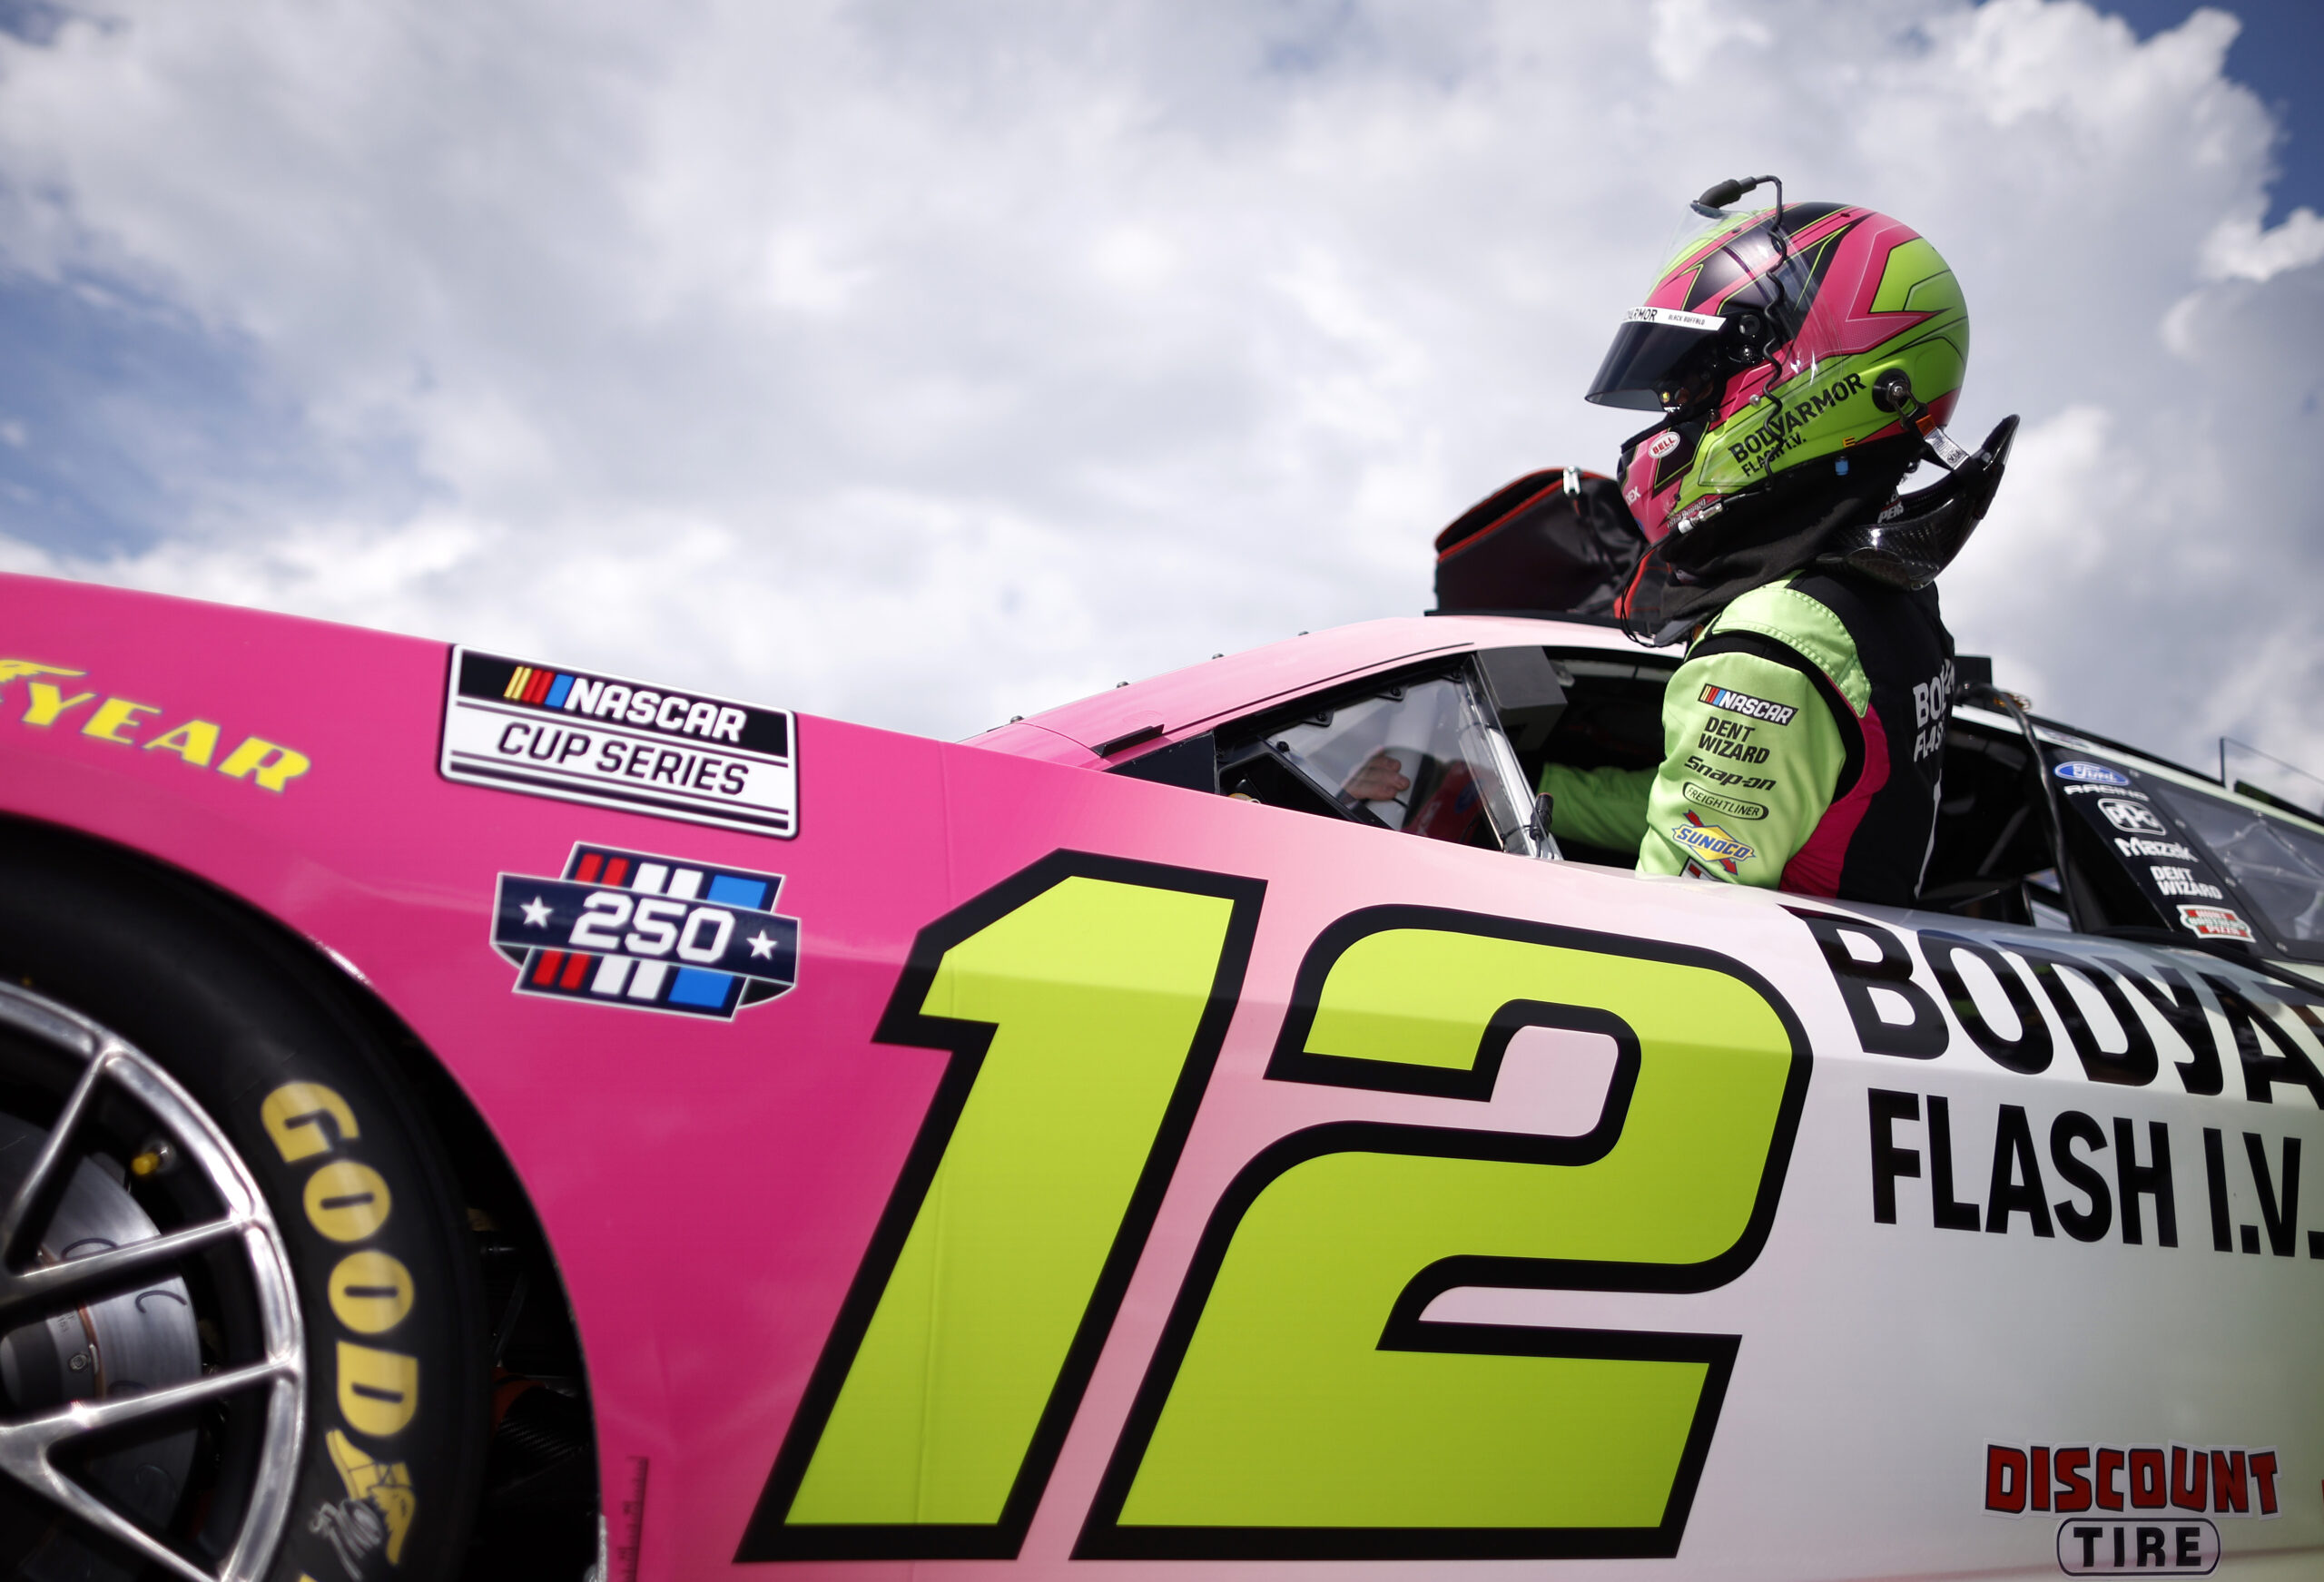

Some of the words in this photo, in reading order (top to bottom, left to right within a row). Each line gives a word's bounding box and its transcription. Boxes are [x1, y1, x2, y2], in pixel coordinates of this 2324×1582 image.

[1652, 436, 1676, 455] BELL
[1728, 372, 1866, 464] BODYARMOR
[21, 681, 311, 792] YEAR
[564, 677, 746, 743] NASCAR
[1704, 716, 1756, 742] DENT
[1718, 690, 1797, 725] NASCAR
[497, 721, 591, 763] CUP
[596, 740, 750, 796] SERIES
[1698, 733, 1770, 764] WIZARD
[1686, 785, 1760, 817] FREIGHTLINER
[1676, 828, 1750, 860] SUNOCO
[2150, 865, 2194, 881] DENT
[2156, 879, 2224, 900] WIZARD
[568, 890, 735, 963] 250
[1777, 904, 2324, 1111] BODYA
[733, 847, 1814, 1561] 12
[1867, 1087, 2179, 1248] FLASH
[2203, 1126, 2324, 1260] I.V.
[261, 1080, 419, 1438] GOOD
[1984, 1444, 2280, 1515] DISCOUNT
[2073, 1527, 2202, 1567] TIRE
